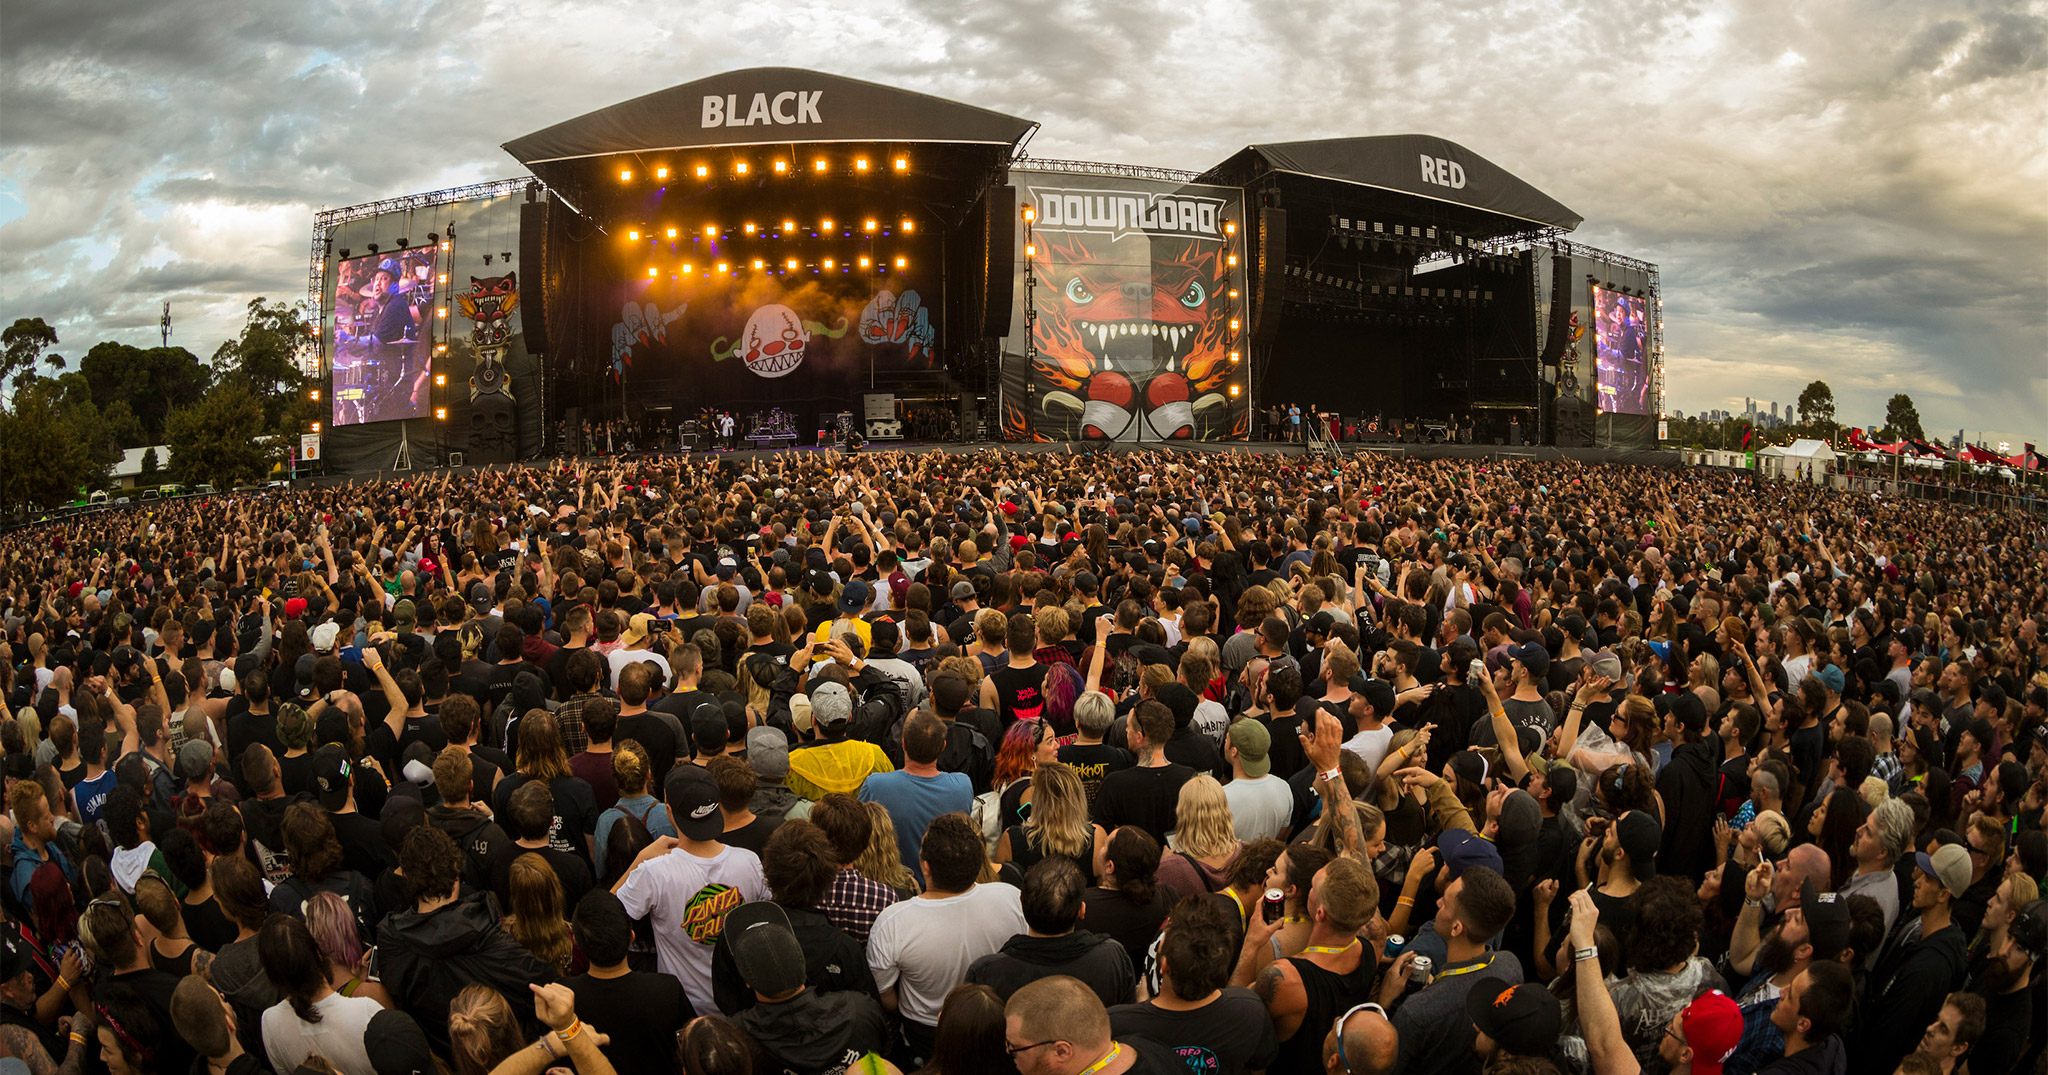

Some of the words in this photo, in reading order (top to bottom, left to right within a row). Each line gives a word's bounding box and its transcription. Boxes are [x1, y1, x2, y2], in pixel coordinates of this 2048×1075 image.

[702, 91, 824, 129] BLACK
[1420, 154, 1466, 190] RED
[1039, 193, 1220, 235] DOWNLOAD
[1200, 721, 1225, 734] HABITS
[86, 793, 107, 815] SIMMO
[681, 887, 741, 928] SANTA
[691, 915, 723, 942] CRU
